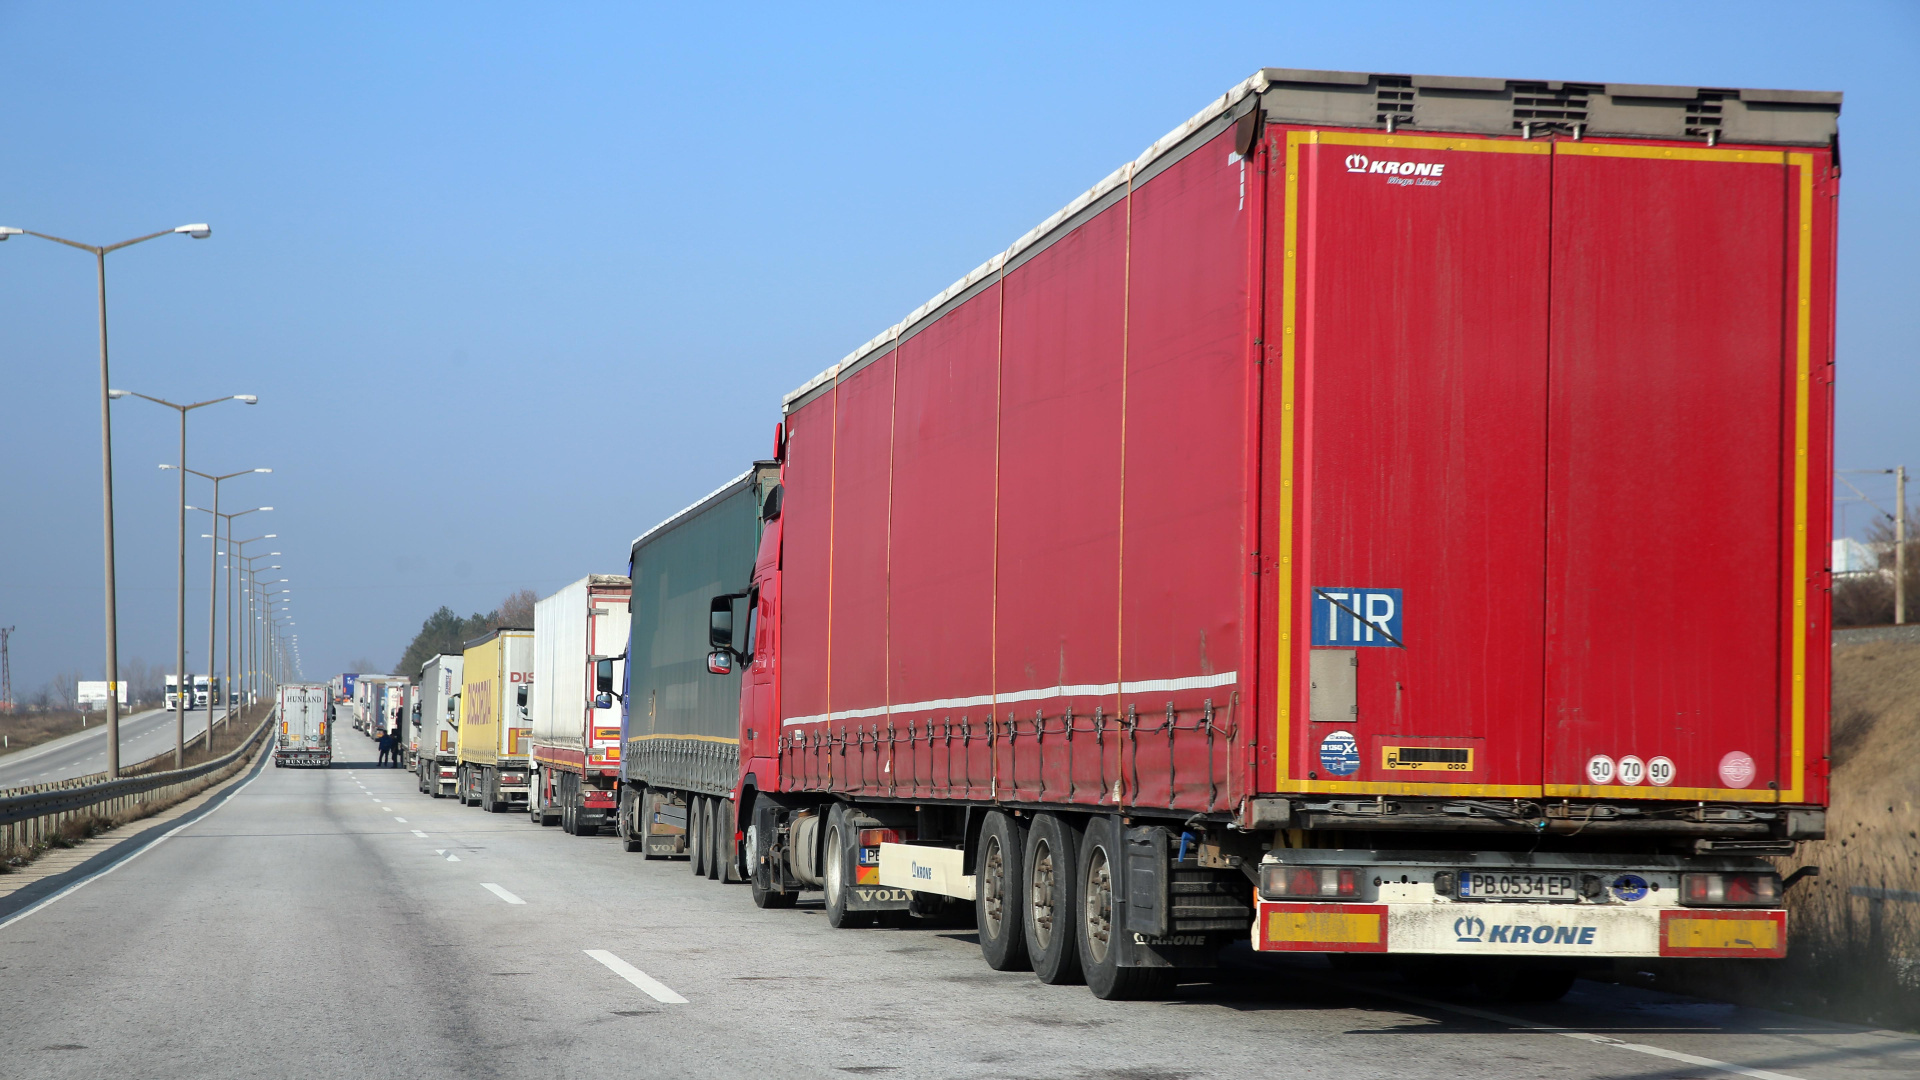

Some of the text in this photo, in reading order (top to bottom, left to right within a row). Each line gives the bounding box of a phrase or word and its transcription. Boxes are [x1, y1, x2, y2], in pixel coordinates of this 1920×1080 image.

[1369, 160, 1445, 177] KRONE
[1387, 176, 1442, 187] Mega Liner
[1318, 592, 1395, 642] TIR
[286, 695, 322, 704] HUNLAND
[285, 758, 322, 766] HUNLAND
[1592, 761, 1610, 776] 50
[1623, 762, 1641, 777] 70
[1651, 763, 1670, 778] 90
[916, 866, 932, 880] KRONE
[1489, 924, 1597, 945] KRONE
